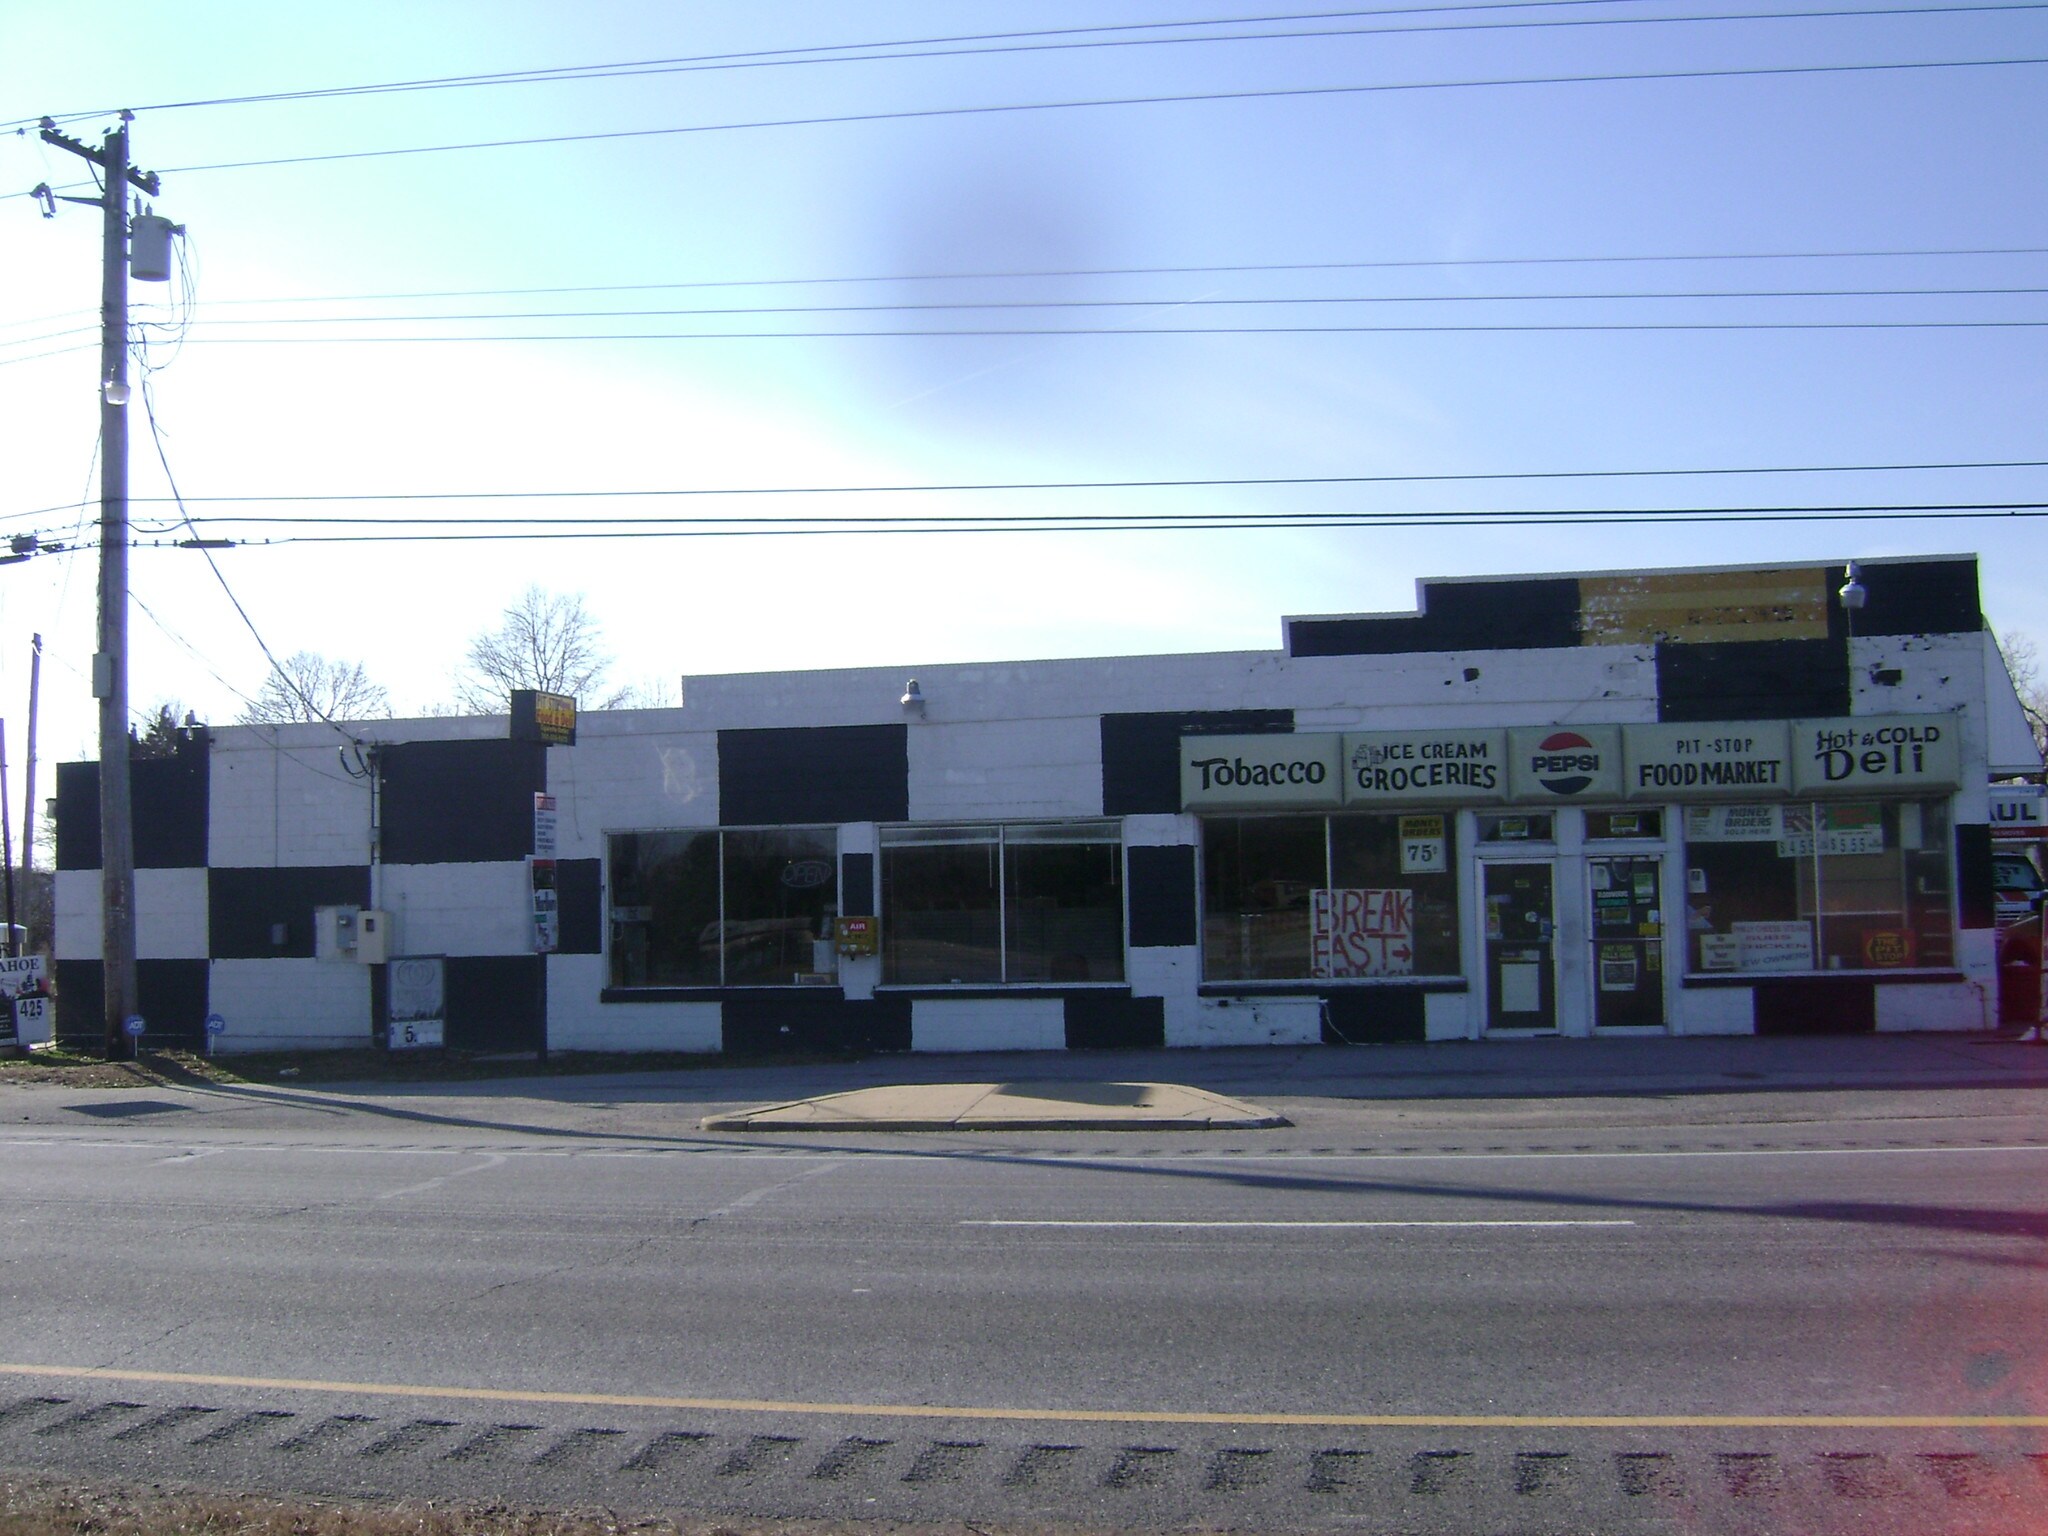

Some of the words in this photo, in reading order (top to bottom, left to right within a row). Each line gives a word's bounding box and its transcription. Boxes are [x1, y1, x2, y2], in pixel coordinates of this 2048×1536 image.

[1816, 728, 1855, 750] Hot
[1876, 727, 1940, 744] COLD
[1383, 744, 1415, 760] ICE
[1421, 743, 1488, 759] CREAM
[1532, 755, 1600, 772] PEPSI
[1815, 745, 1924, 781] Deli
[1191, 757, 1326, 791] Tobacco
[1358, 762, 1497, 791] GROCERIES
[1728, 807, 1771, 817] MONEY
[1724, 818, 1773, 827] ORDERS
[1724, 828, 1746, 836] SOLD
[783, 864, 828, 884] OPEN
[850, 922, 866, 930] AIR
[1313, 932, 1407, 971] FAST
[1875, 952, 1903, 961] STOP
[20, 1000, 43, 1017] 425
[129, 1021, 144, 1030] ADT
[208, 1020, 224, 1029] ADT
